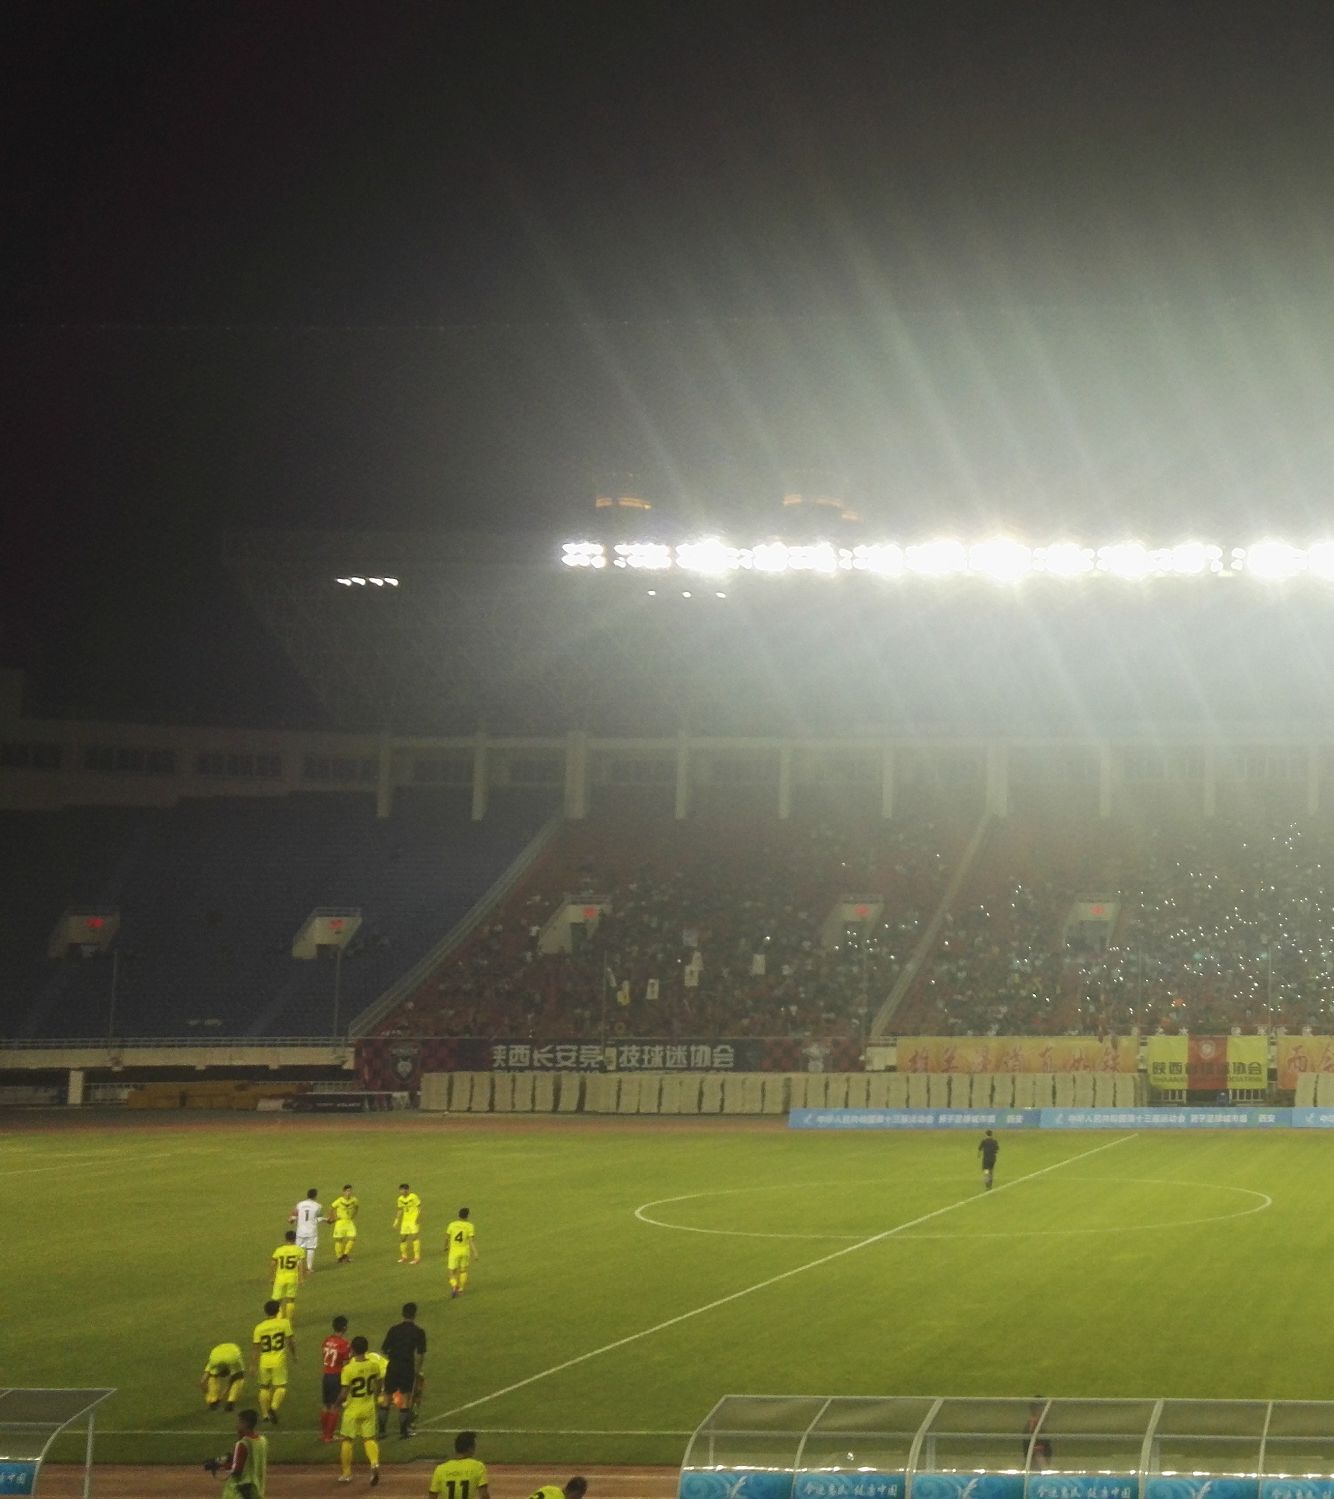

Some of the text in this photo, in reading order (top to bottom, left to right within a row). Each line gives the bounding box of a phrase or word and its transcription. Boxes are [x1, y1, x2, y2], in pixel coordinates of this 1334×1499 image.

[305, 1210, 309, 1221] 1
[454, 1231, 463, 1242] 4
[280, 1256, 297, 1269] 15
[446, 1480, 470, 1499] 11
